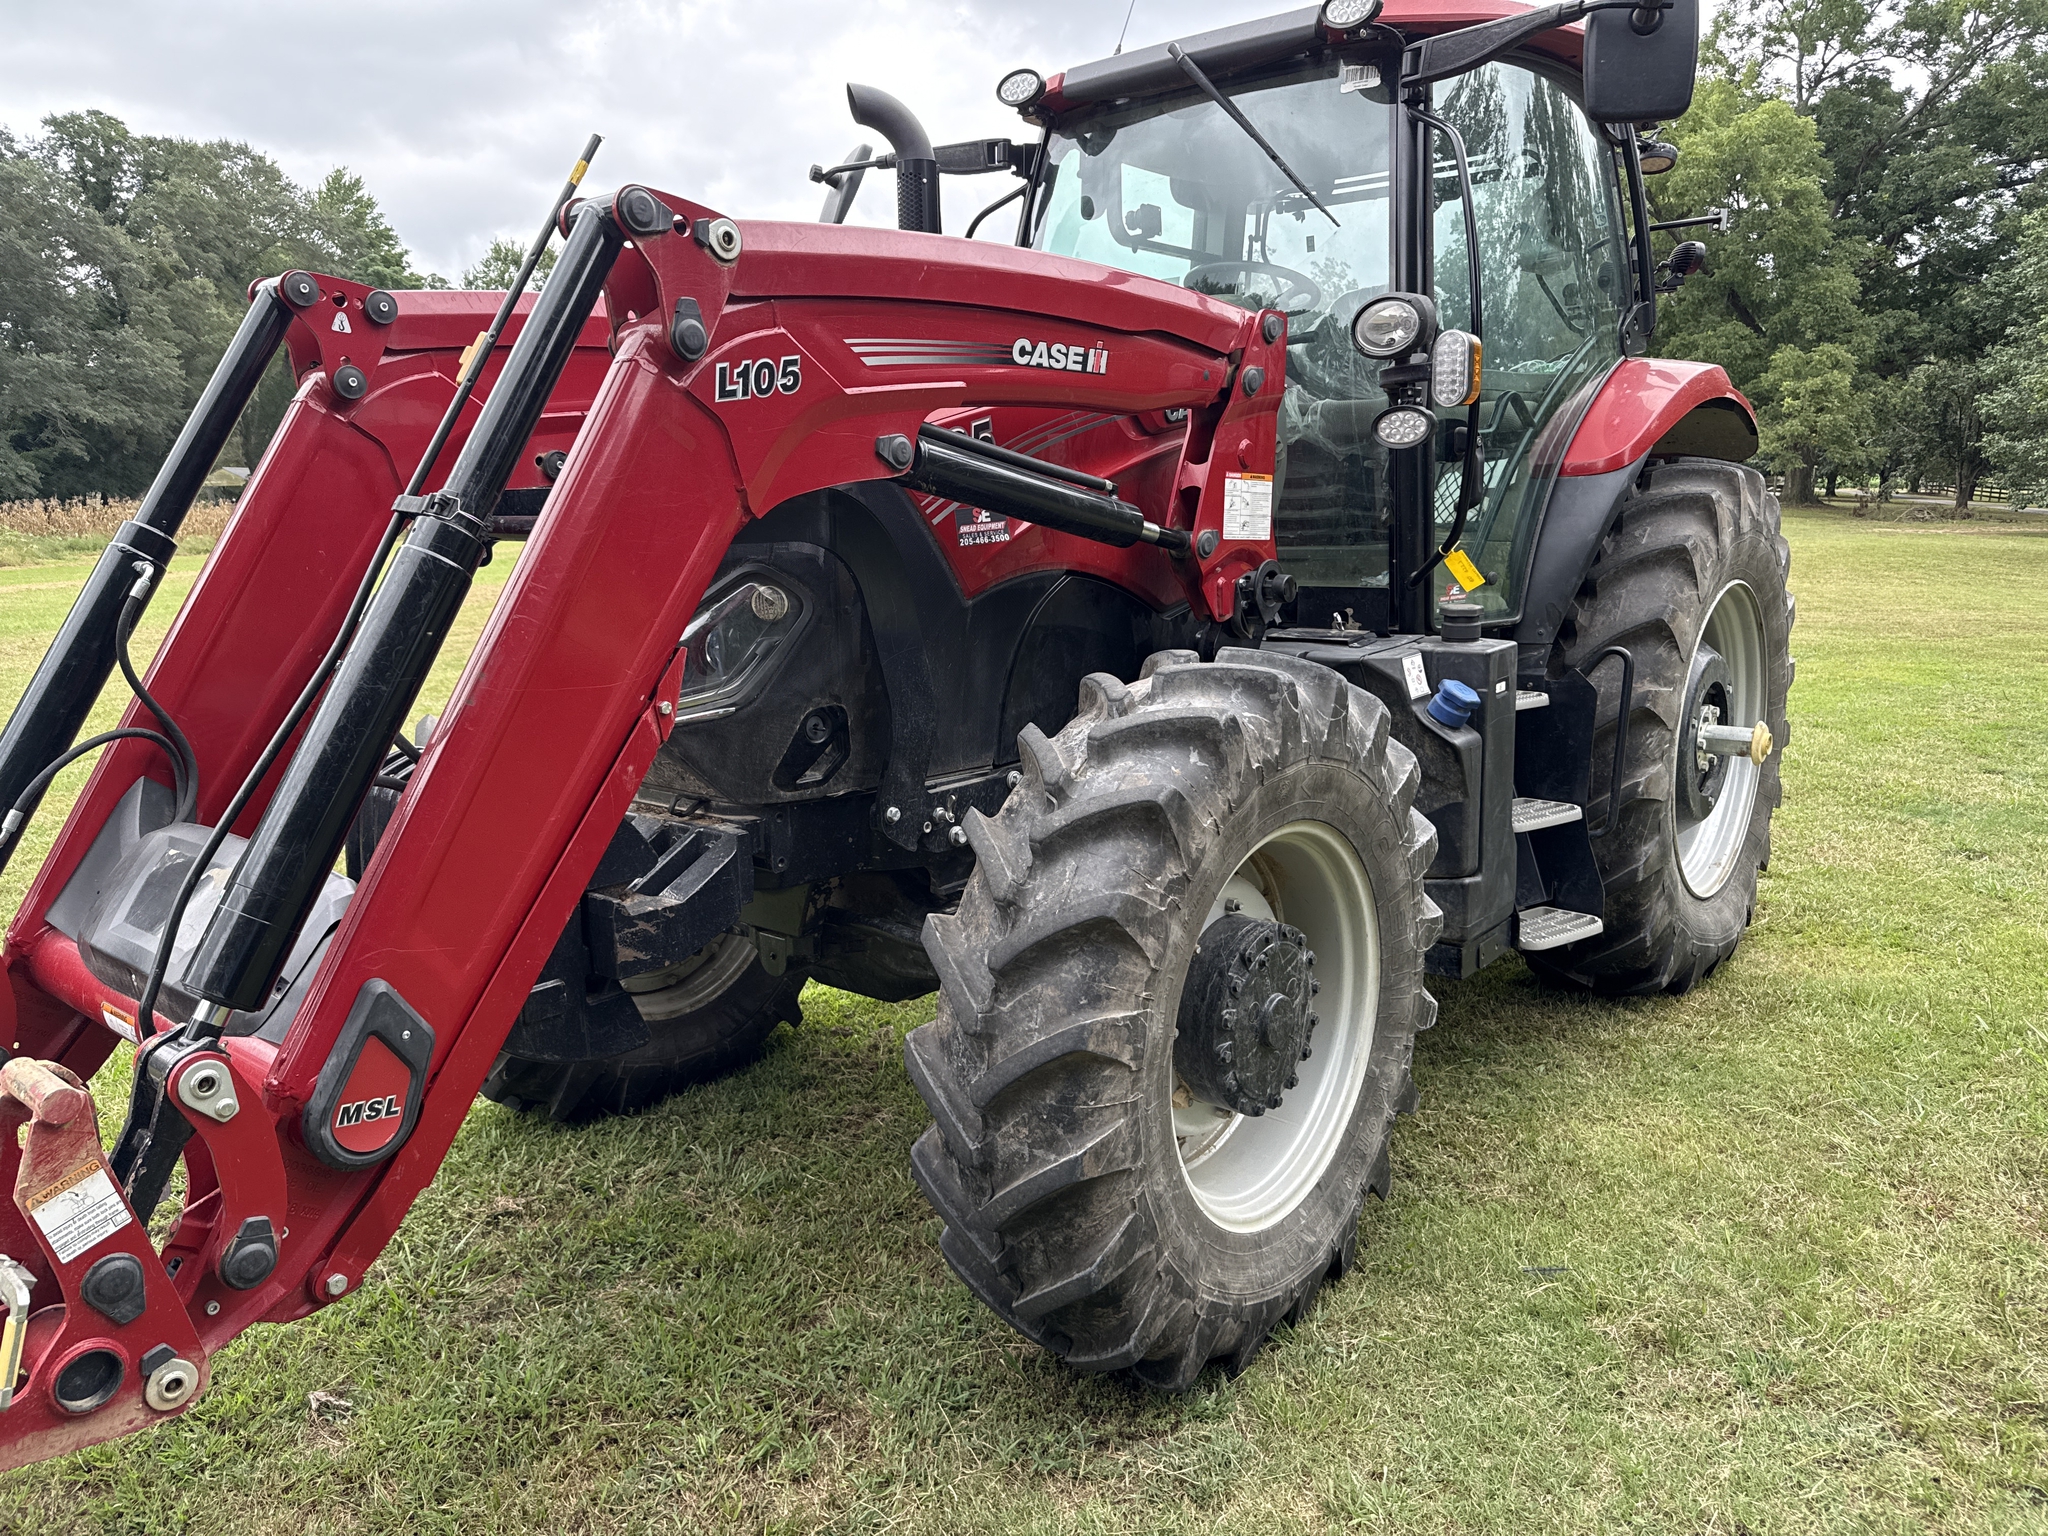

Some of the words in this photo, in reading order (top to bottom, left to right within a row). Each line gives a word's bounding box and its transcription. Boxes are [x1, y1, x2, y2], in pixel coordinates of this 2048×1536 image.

[1012, 338, 1085, 372] CASE
[715, 355, 802, 403] L105
[960, 525, 977, 534] SNEAD
[977, 522, 1006, 531] EQUIPMENT
[960, 533, 1010, 547] 205-466-3500
[335, 1094, 402, 1129] MSL
[43, 1161, 100, 1200] WARNING
